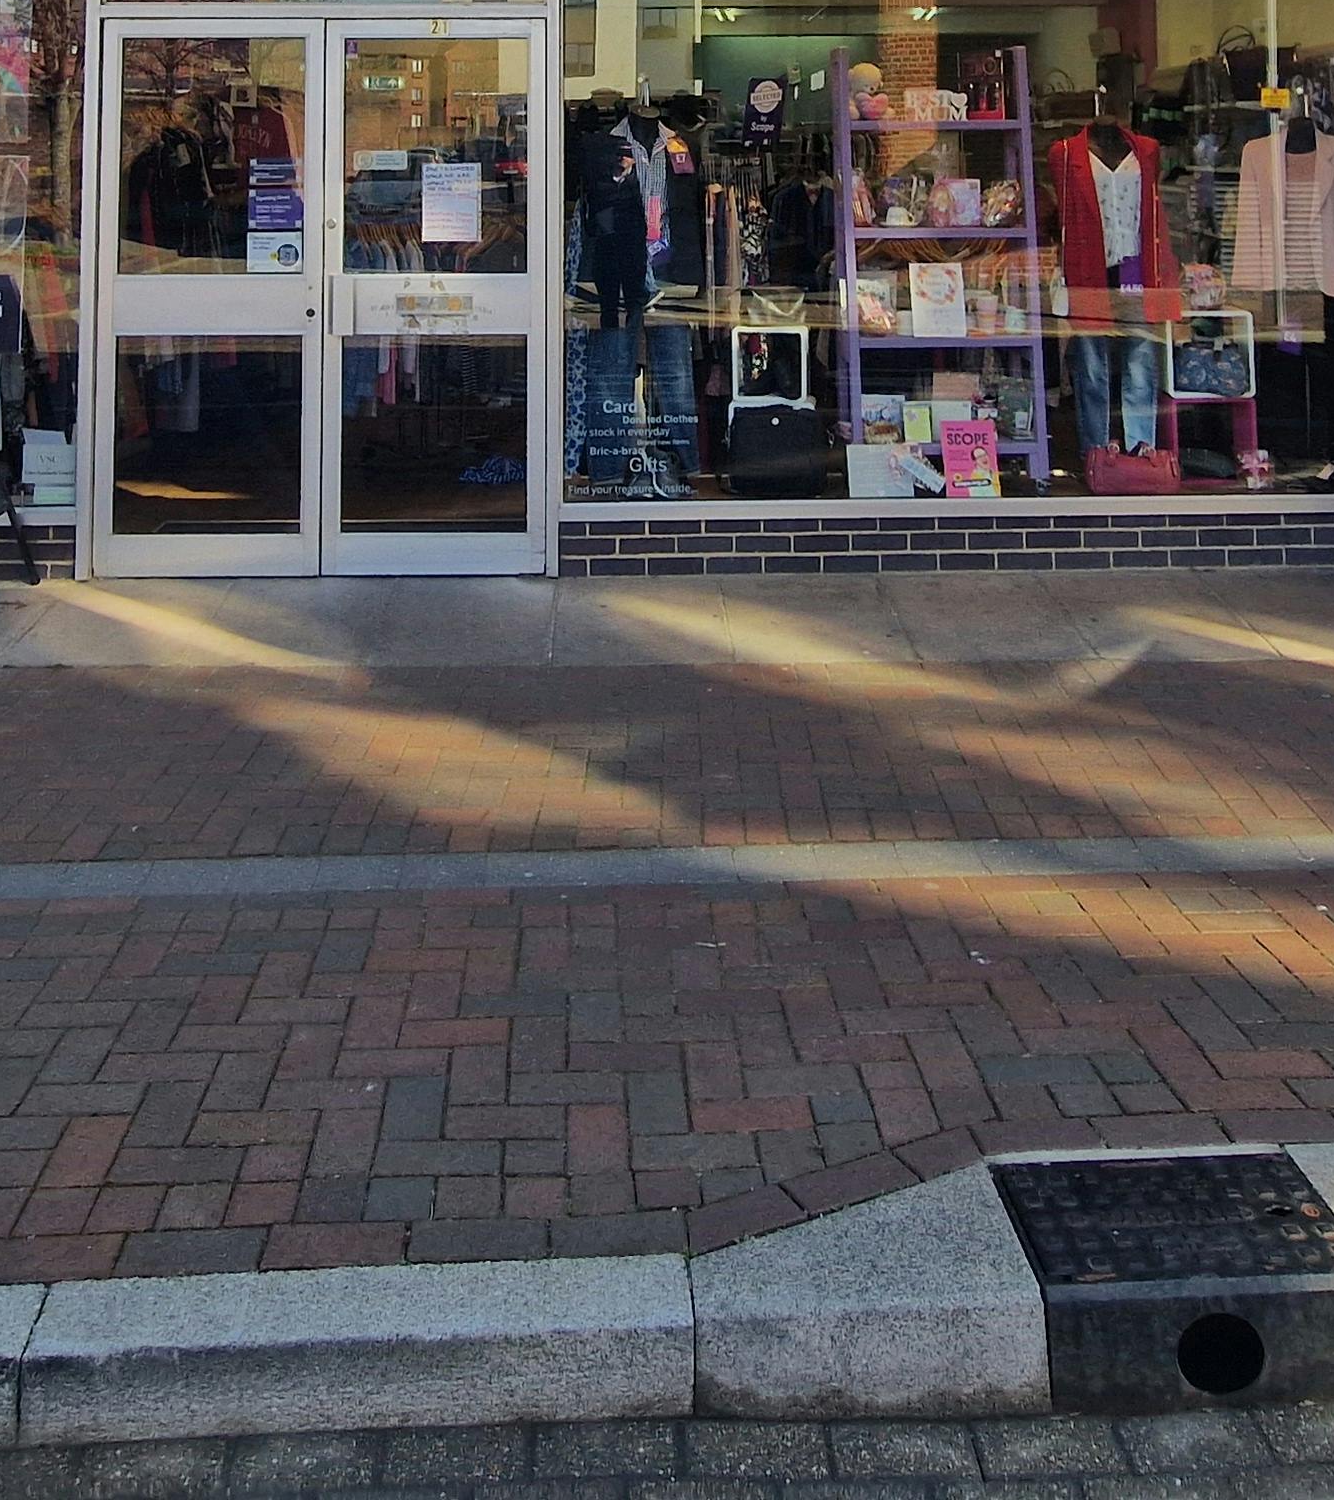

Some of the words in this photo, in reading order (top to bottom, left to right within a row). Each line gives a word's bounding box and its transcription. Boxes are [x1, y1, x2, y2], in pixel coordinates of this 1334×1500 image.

[431, 20, 447, 34] 21
[903, 89, 953, 108] BEST
[914, 106, 968, 122] MUM
[750, 121, 775, 133] Scope
[602, 399, 647, 414] Card
[663, 414, 699, 424] Clothes
[588, 428, 616, 437] stock
[617, 428, 626, 437] in
[627, 428, 670, 439] everyday
[946, 432, 990, 446] SCOPE
[589, 446, 644, 457] Bric-a-brac
[629, 456, 668, 474] Gifts
[568, 484, 590, 495] Find
[591, 485, 612, 497] your
